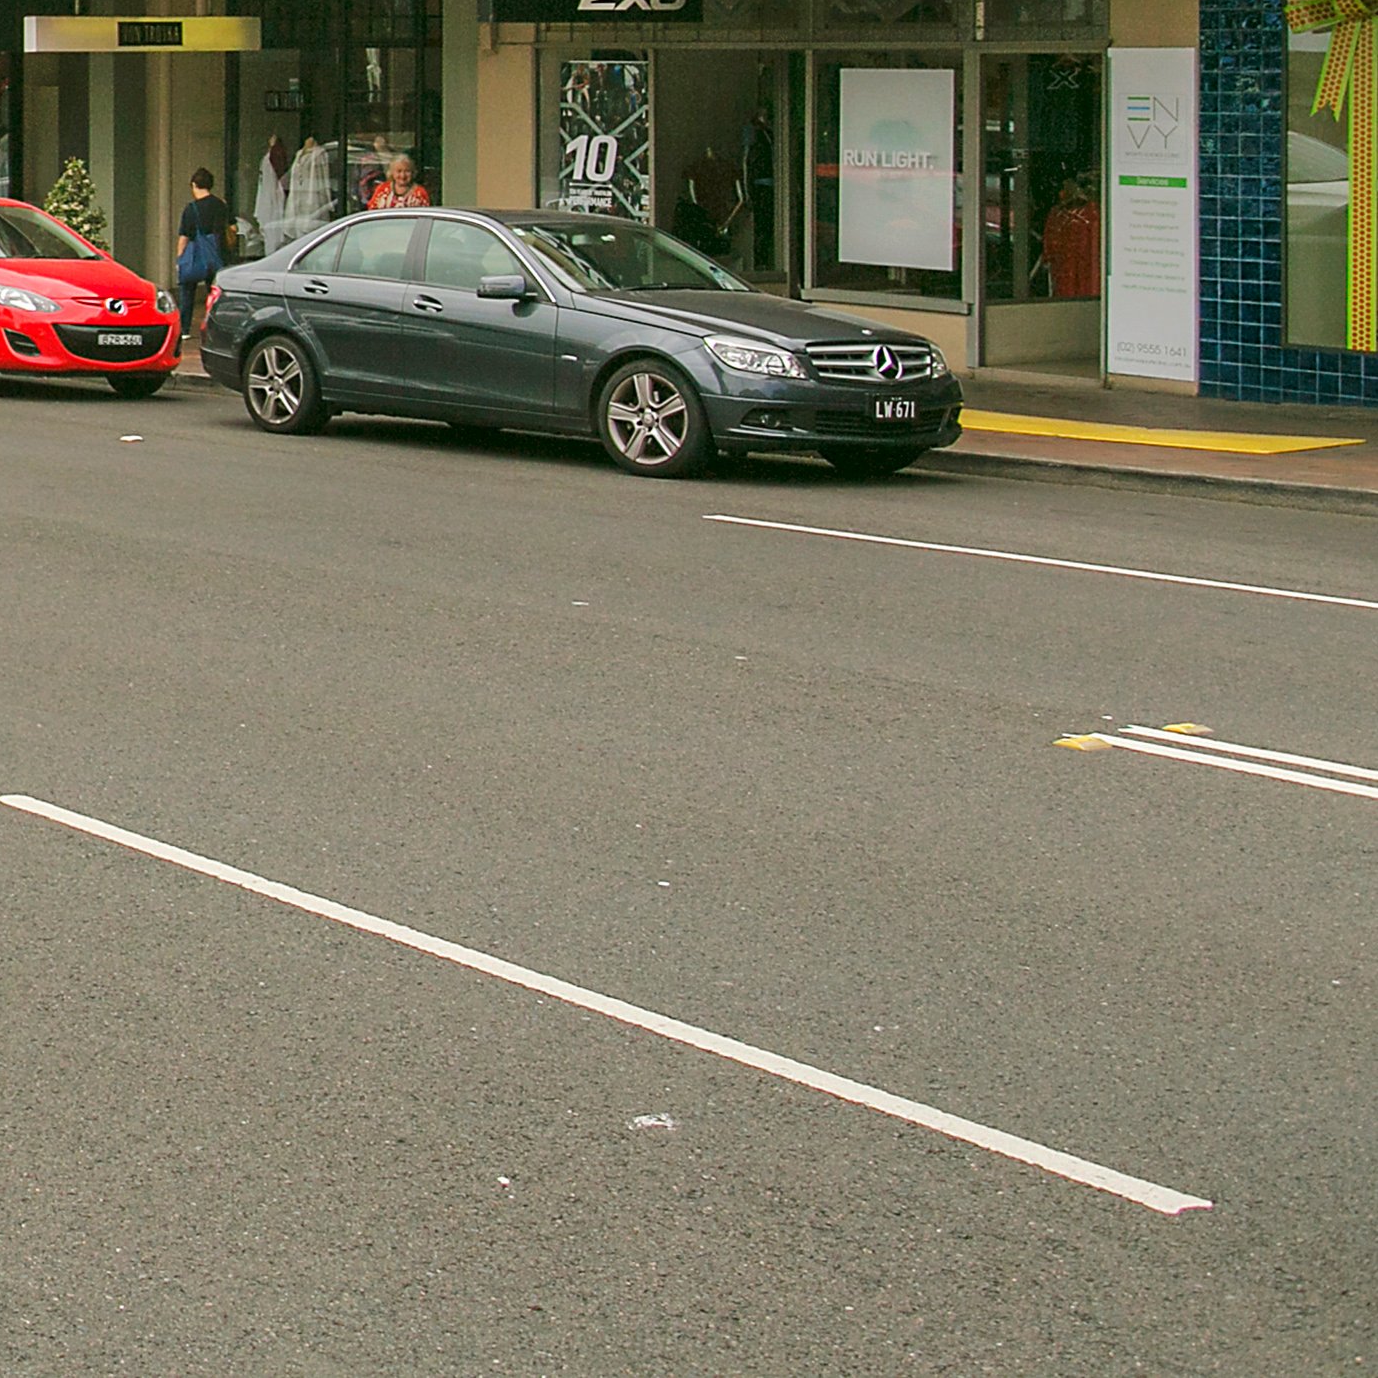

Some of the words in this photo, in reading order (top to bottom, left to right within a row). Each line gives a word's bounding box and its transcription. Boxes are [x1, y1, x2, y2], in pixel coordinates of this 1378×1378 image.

[566, 134, 618, 182] 10
[844, 149, 878, 167] RUN
[881, 150, 934, 170] LIGHT.
